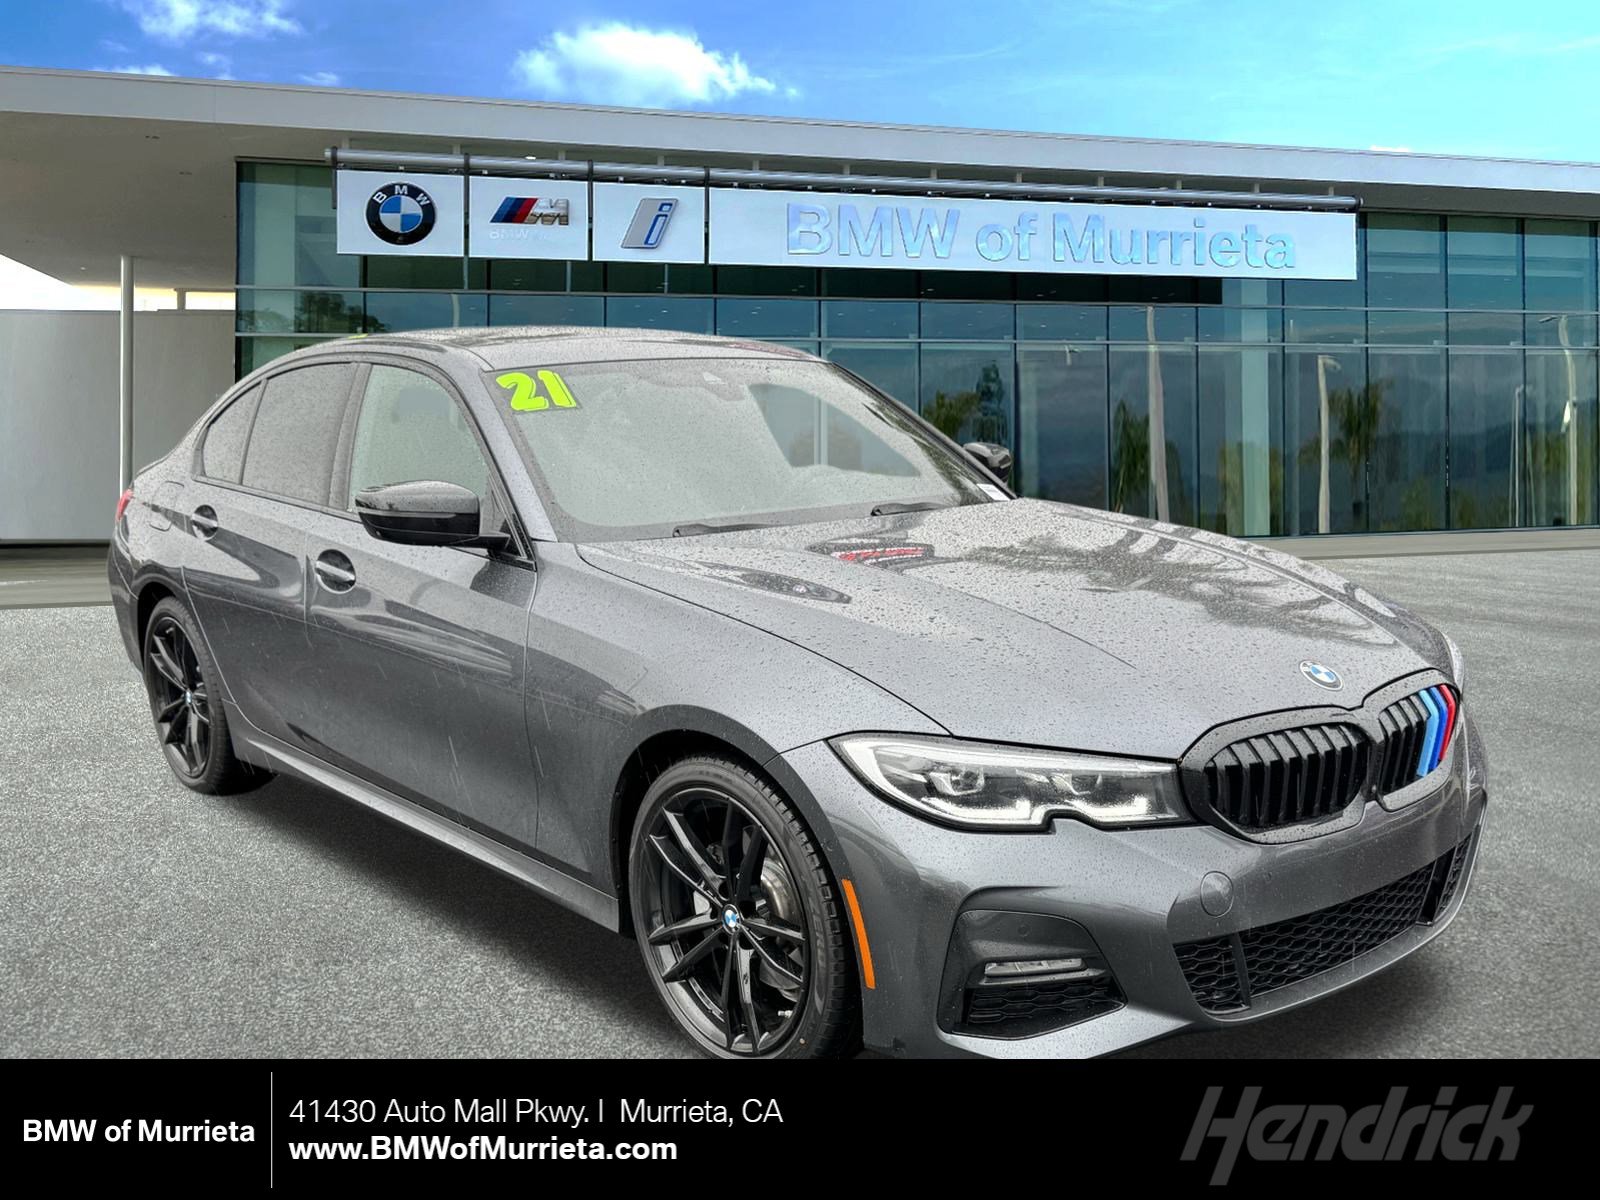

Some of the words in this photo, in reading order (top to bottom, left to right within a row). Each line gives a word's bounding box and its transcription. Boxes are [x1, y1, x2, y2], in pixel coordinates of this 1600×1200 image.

[373, 184, 430, 206] BMW
[787, 203, 961, 259] BMW
[976, 211, 1040, 262] of
[1052, 213, 1296, 270] Murrieta
[495, 370, 577, 412] 21
